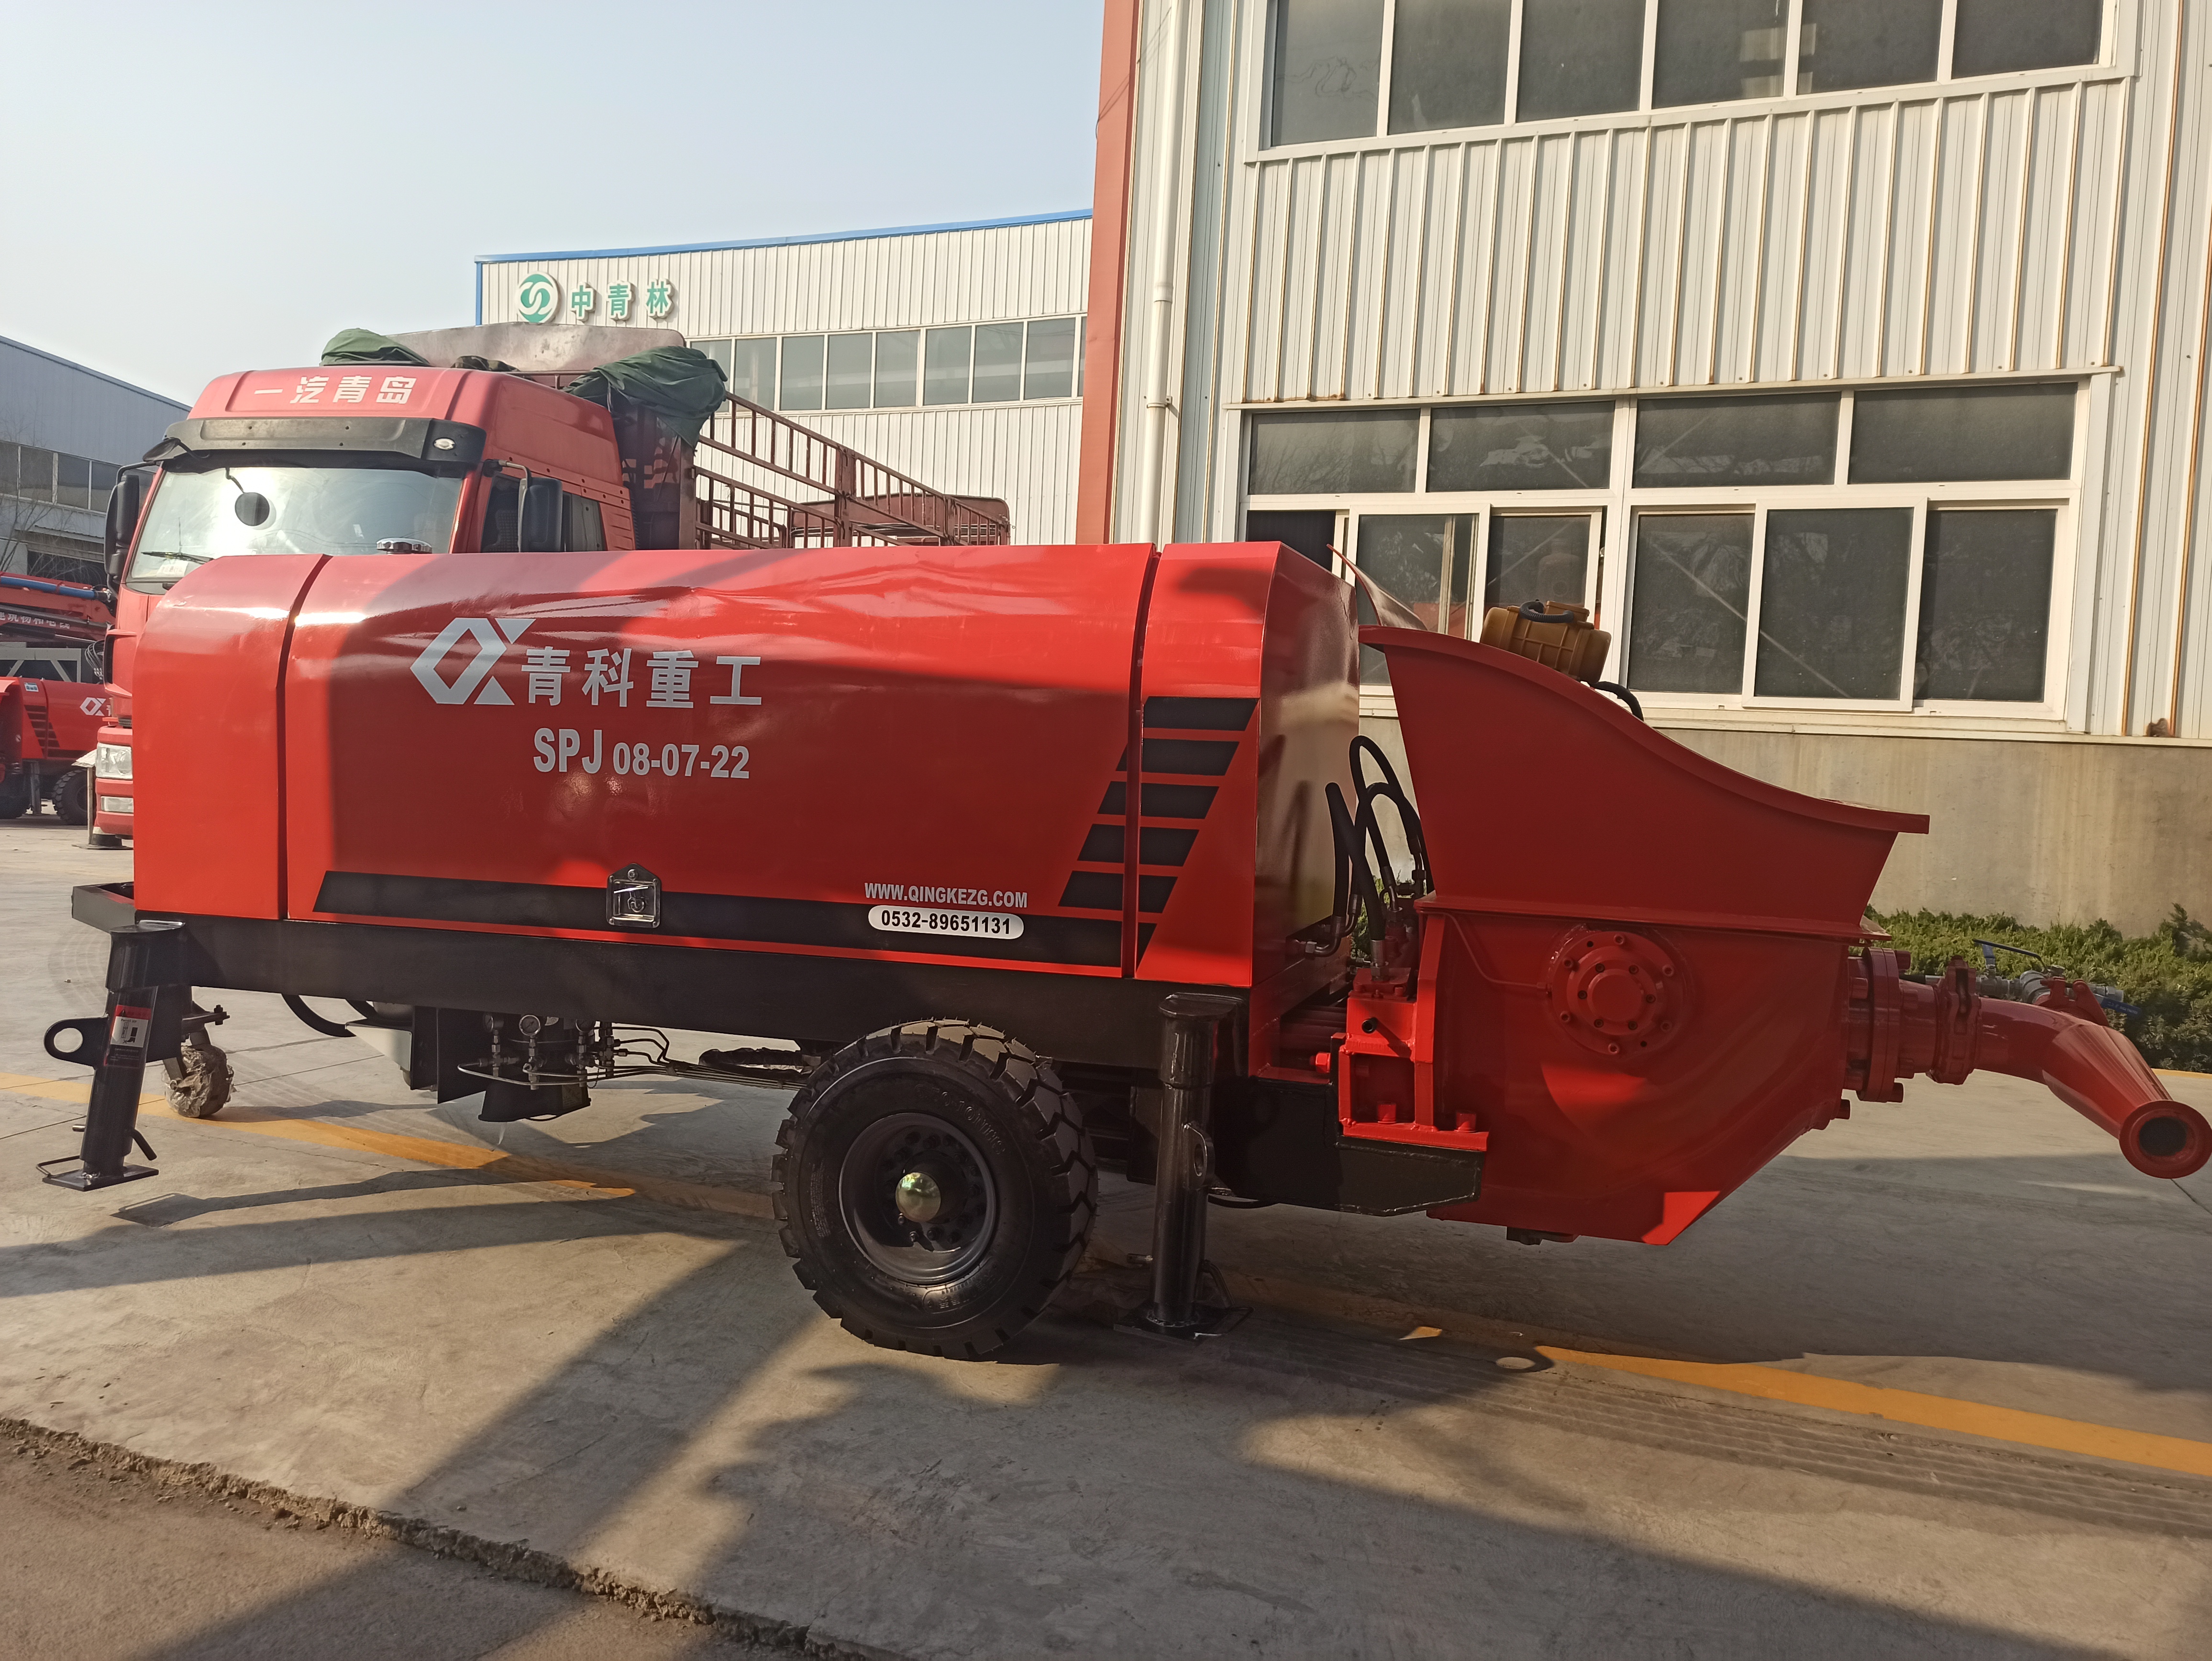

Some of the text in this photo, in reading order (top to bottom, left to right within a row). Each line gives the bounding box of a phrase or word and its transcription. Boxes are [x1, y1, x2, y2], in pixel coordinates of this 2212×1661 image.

[571, 280, 670, 317] 中青林
[254, 375, 417, 404] 一汽青岛
[521, 646, 762, 708] 青科重工
[533, 727, 750, 779] SPJ 08-07-22
[864, 883, 1028, 908] WWW.QINGKEZG.COM
[881, 910, 1010, 934] 0532-89651131
